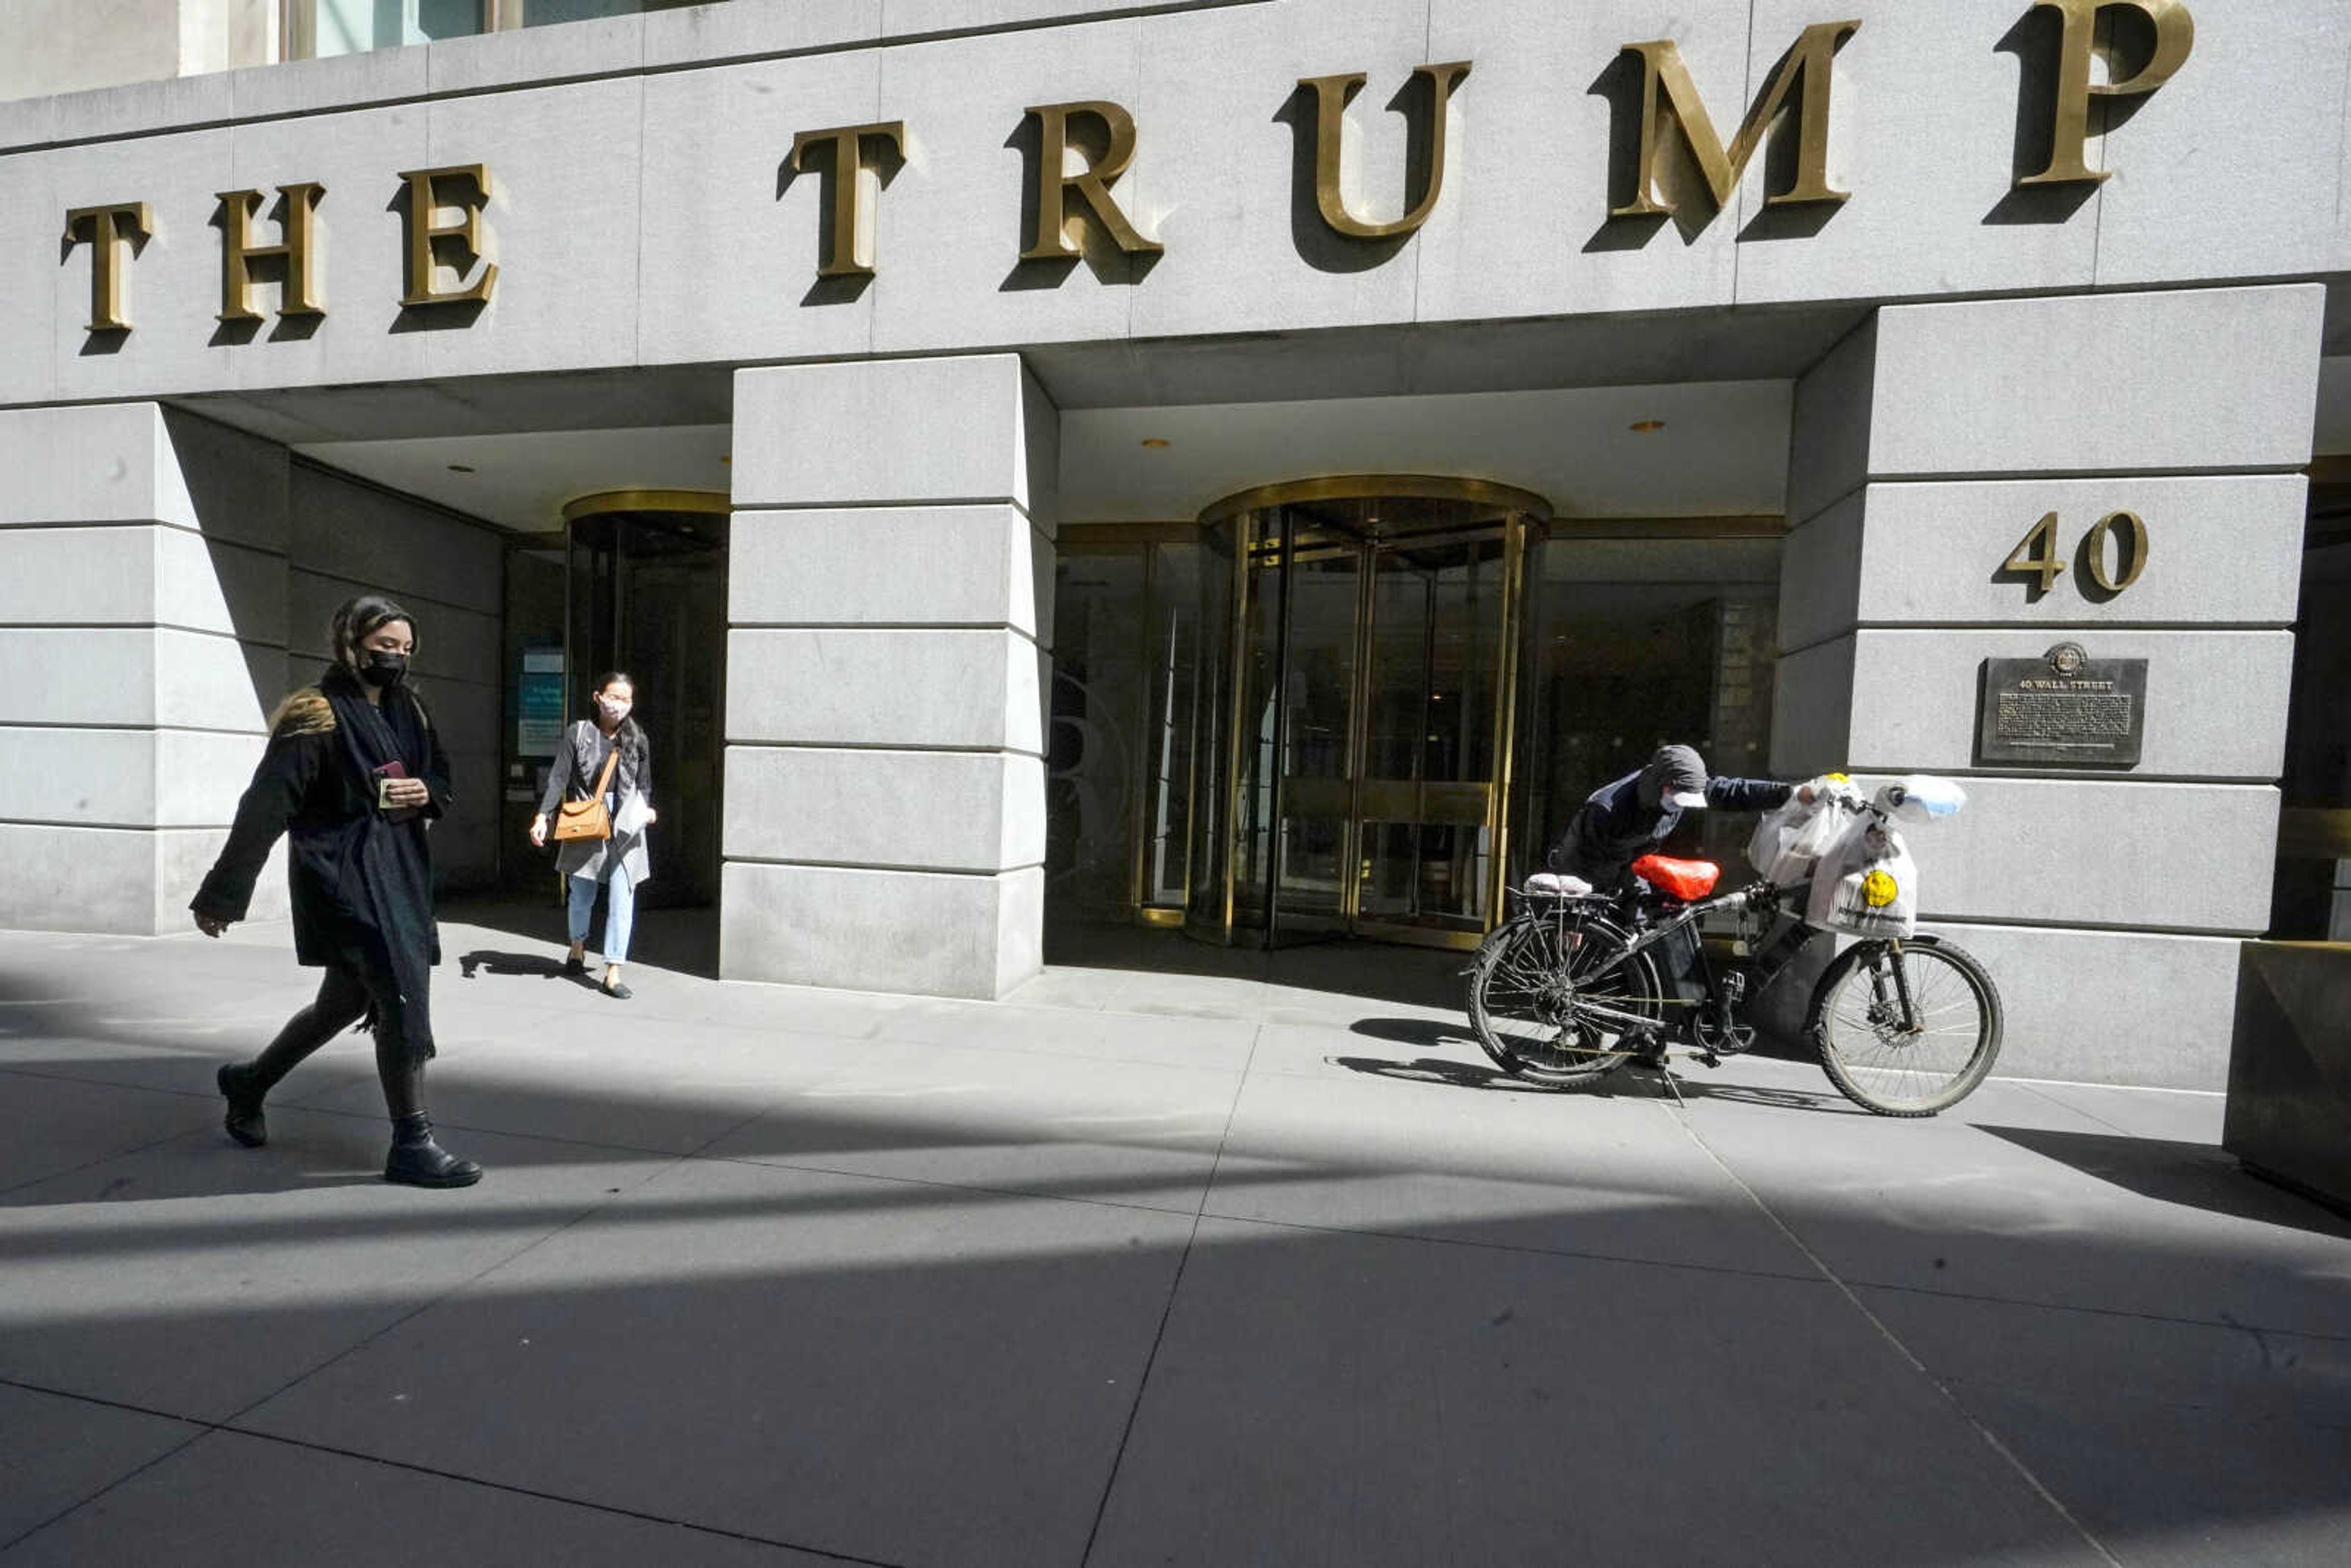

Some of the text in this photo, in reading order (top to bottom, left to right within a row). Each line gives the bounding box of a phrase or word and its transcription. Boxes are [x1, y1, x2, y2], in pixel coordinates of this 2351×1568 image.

[63, 0, 2194, 331] THE TRUMP
[2003, 509, 2149, 591] 40
[2020, 680, 2114, 690] 40 WALL STREET
